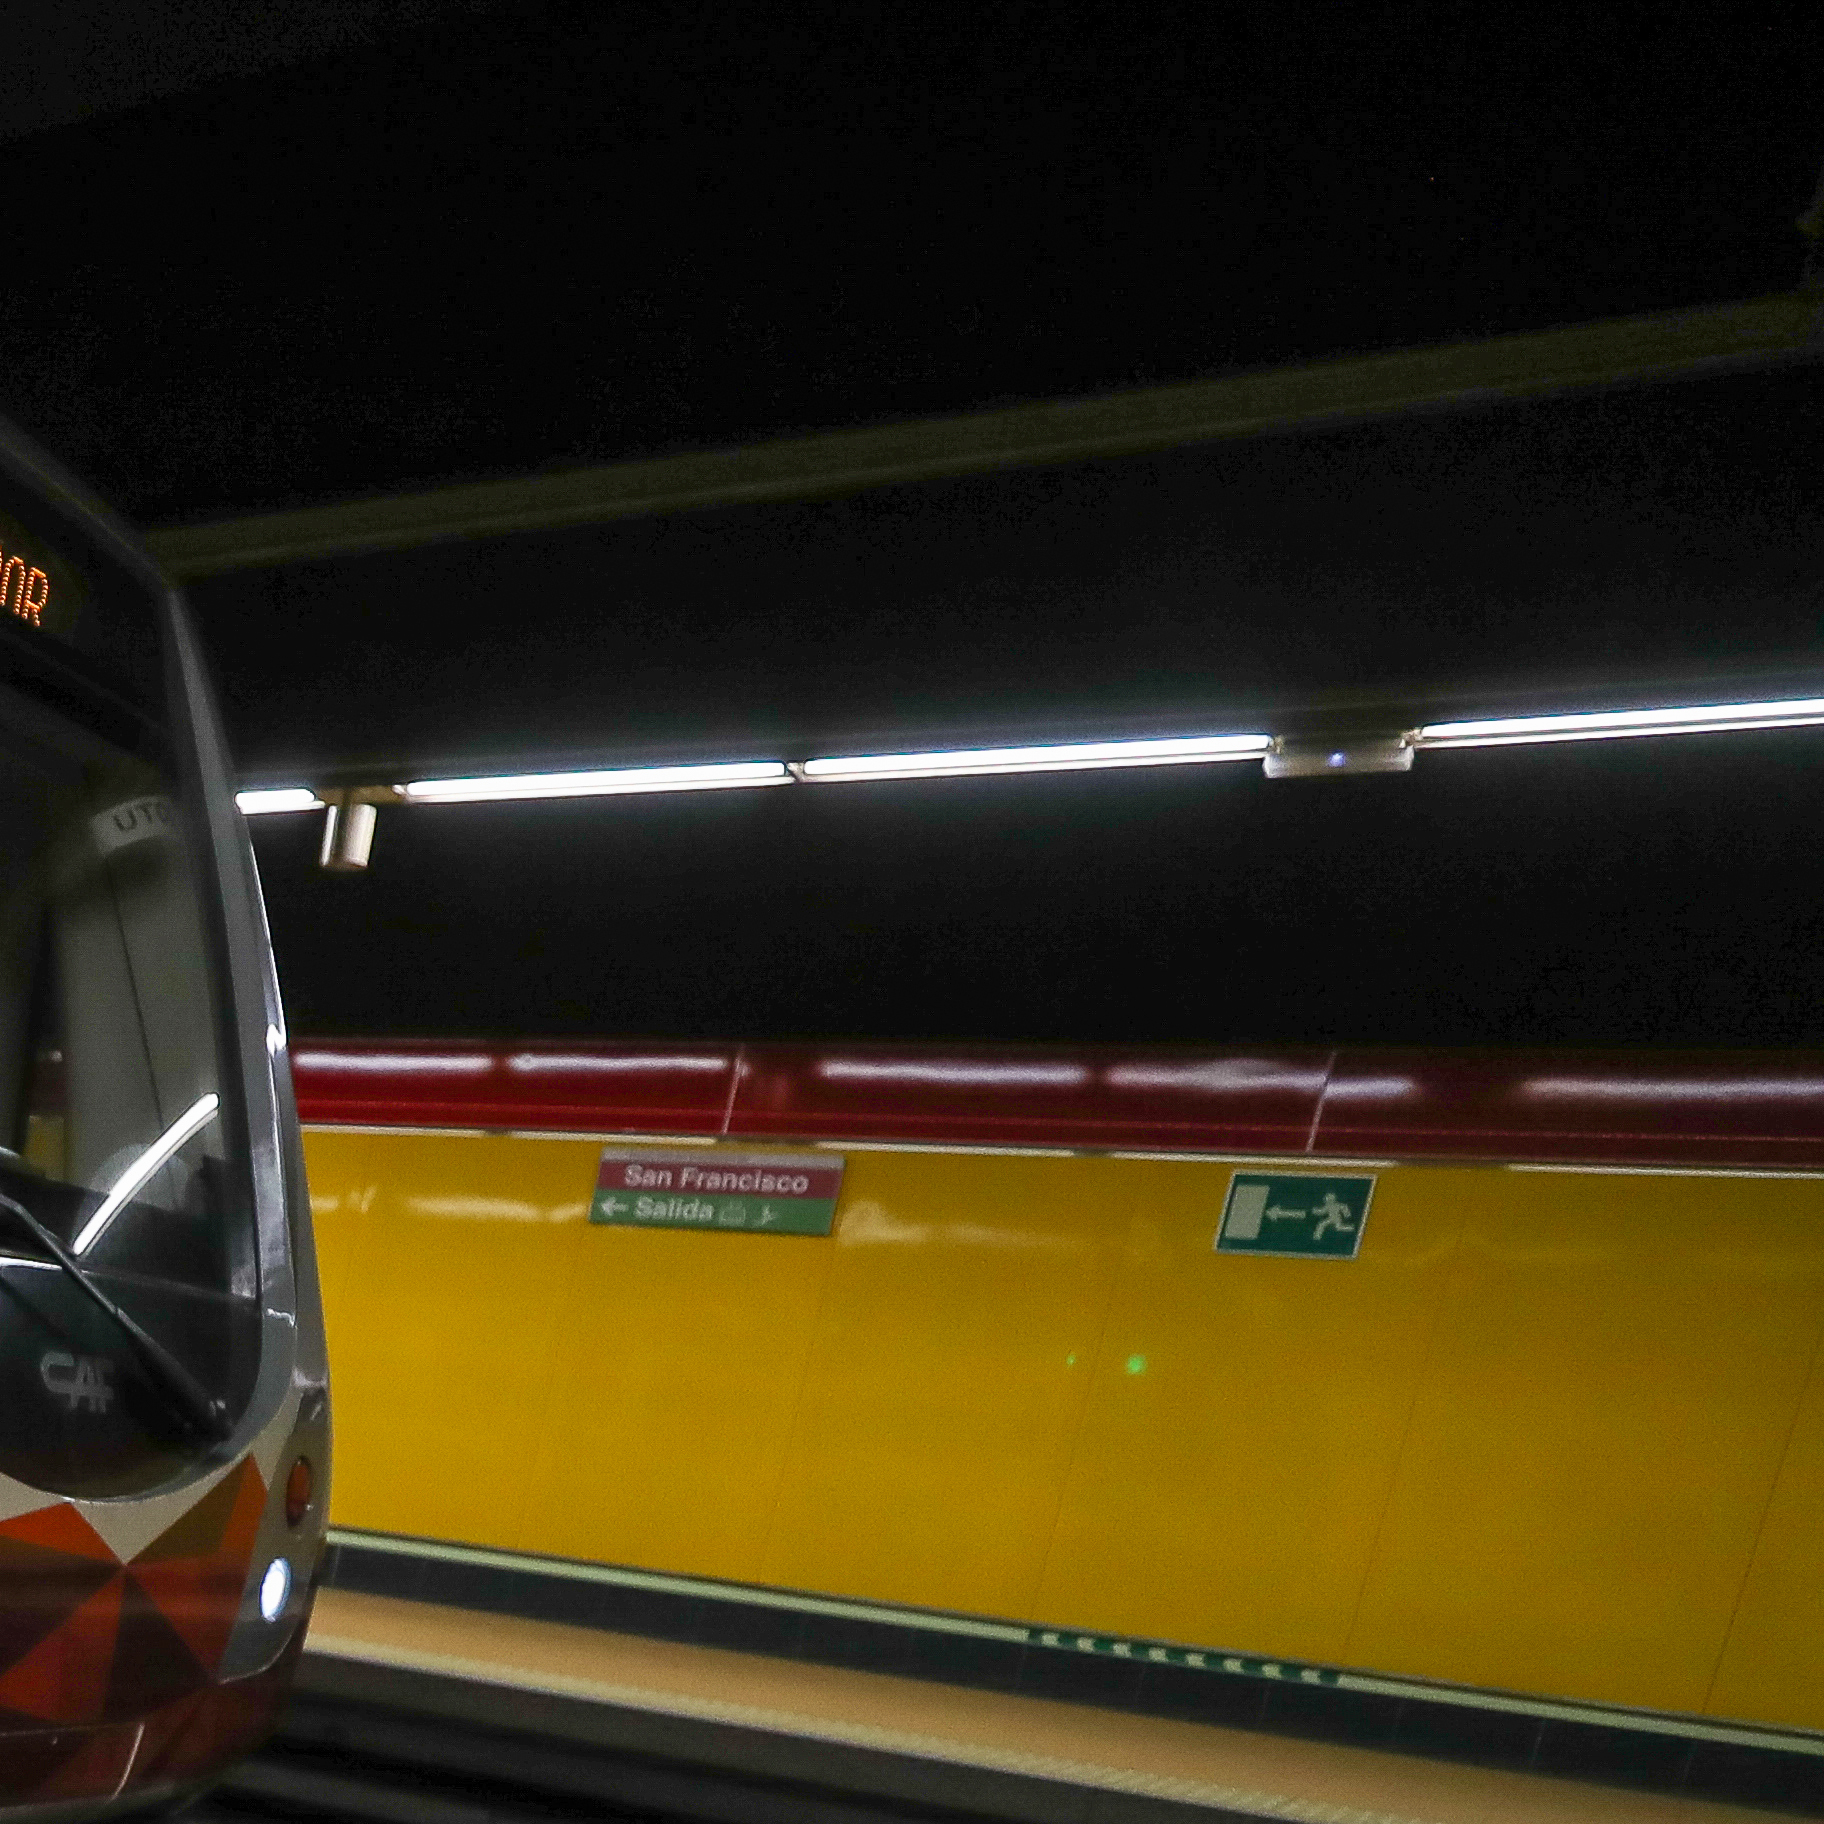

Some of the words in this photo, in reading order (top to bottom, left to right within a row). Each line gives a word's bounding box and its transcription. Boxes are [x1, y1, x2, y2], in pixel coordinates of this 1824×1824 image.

[624, 1163, 673, 1188] San
[678, 1165, 810, 1195] Francisco
[633, 1196, 714, 1222] Salida
